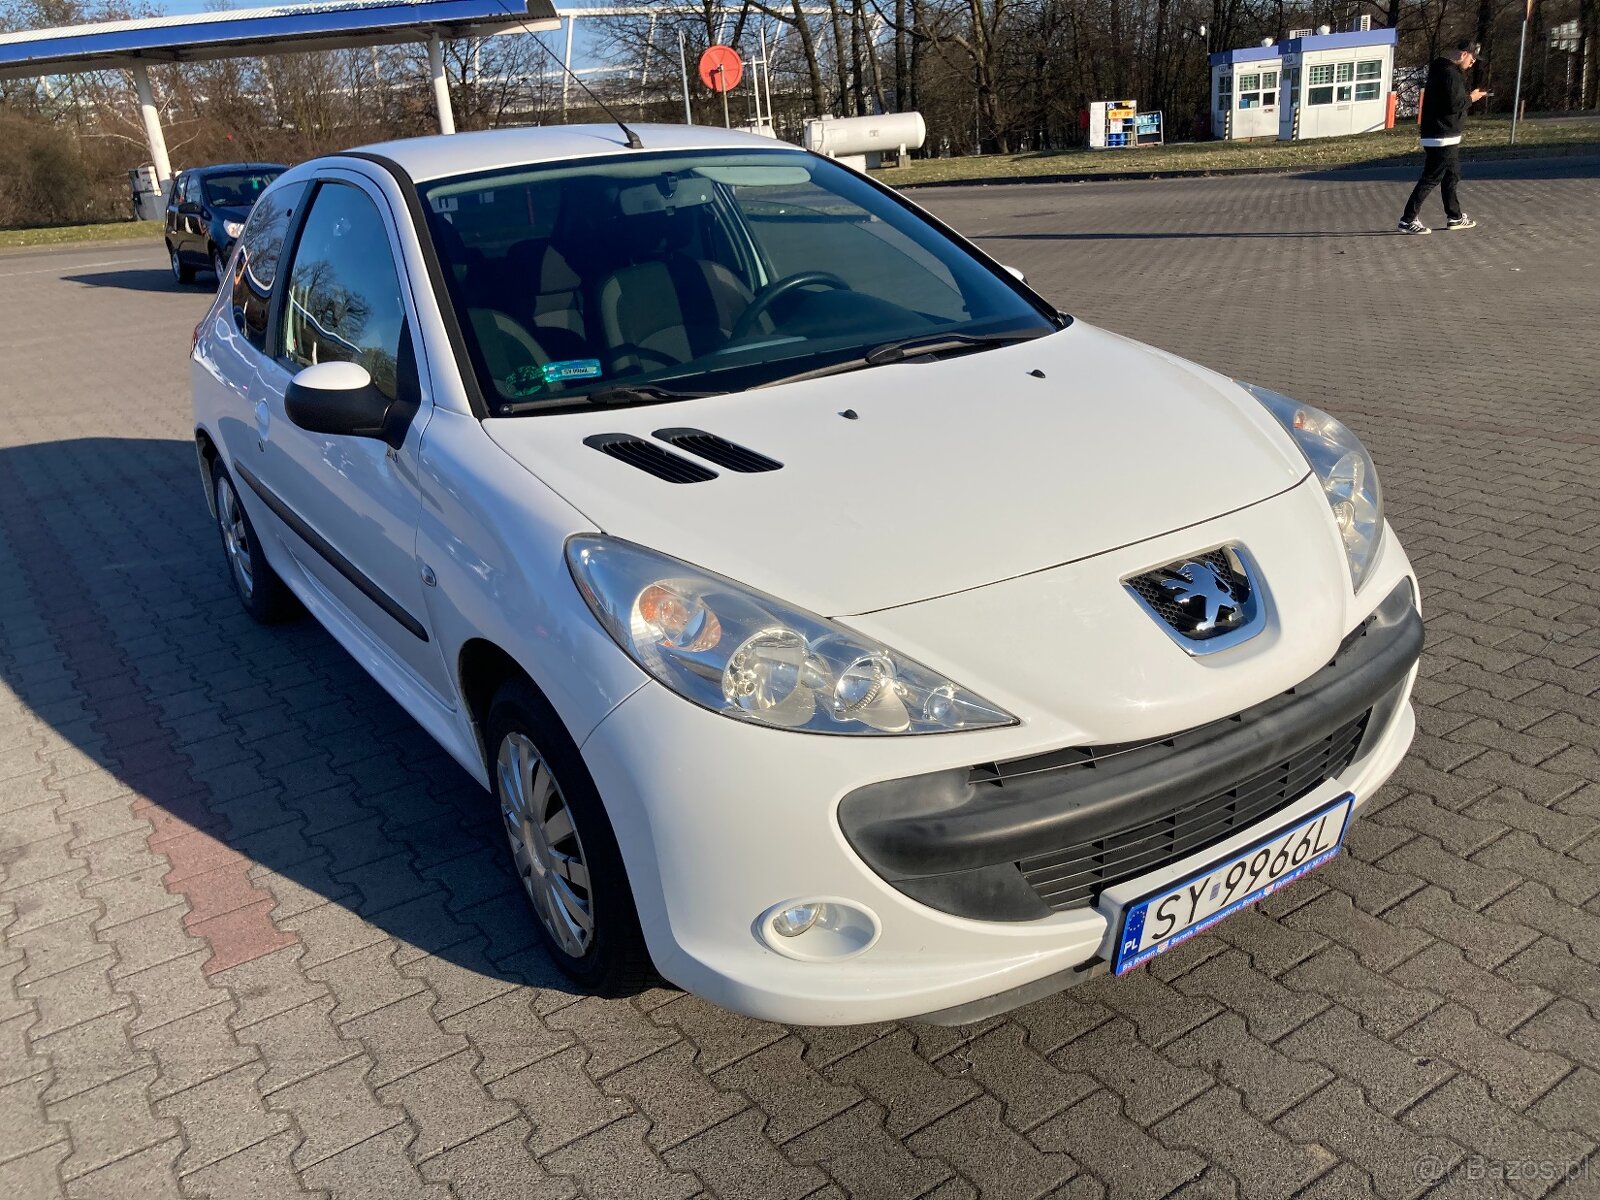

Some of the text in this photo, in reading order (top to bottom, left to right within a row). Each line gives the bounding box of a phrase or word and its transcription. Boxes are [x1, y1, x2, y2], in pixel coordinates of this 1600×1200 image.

[1151, 815, 1330, 940] SY 9966L
[1123, 937, 1139, 955] PL
